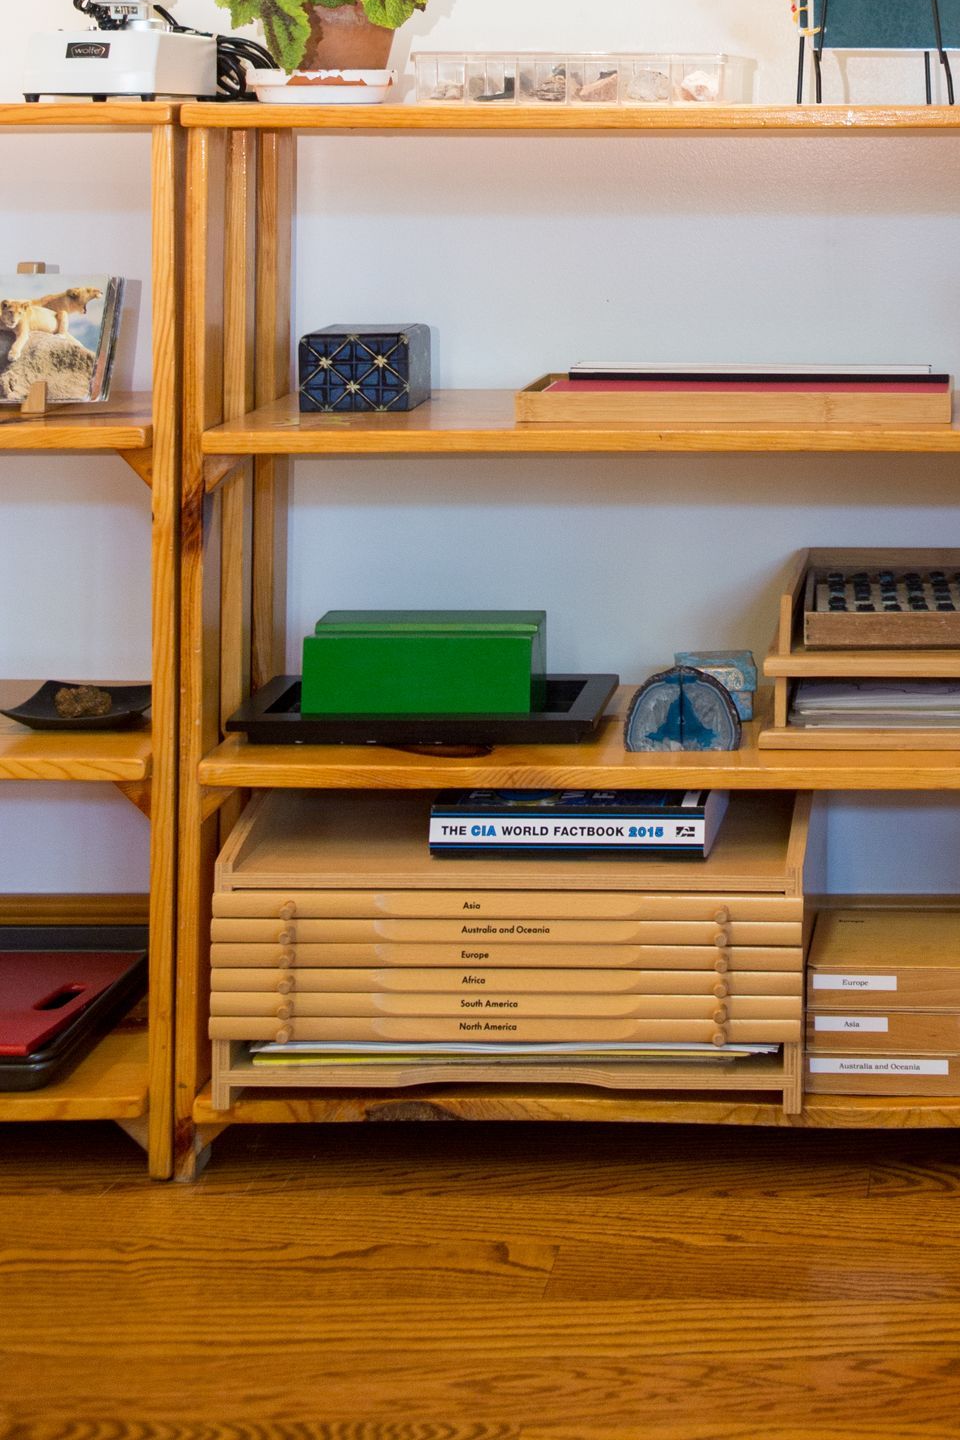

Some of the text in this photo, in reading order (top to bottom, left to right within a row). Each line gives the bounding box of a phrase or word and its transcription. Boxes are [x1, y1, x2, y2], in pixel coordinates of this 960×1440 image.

[442, 825, 664, 837] THE CIA WORLD FACTBOOK 2015
[461, 925, 550, 934] Australia and Oceania
[461, 951, 489, 960] Europe
[462, 976, 486, 984] Africa
[842, 979, 868, 987] Europe
[461, 1000, 518, 1008] South America
[459, 1022, 517, 1030] North America
[890, 1063, 921, 1071] Oceania
